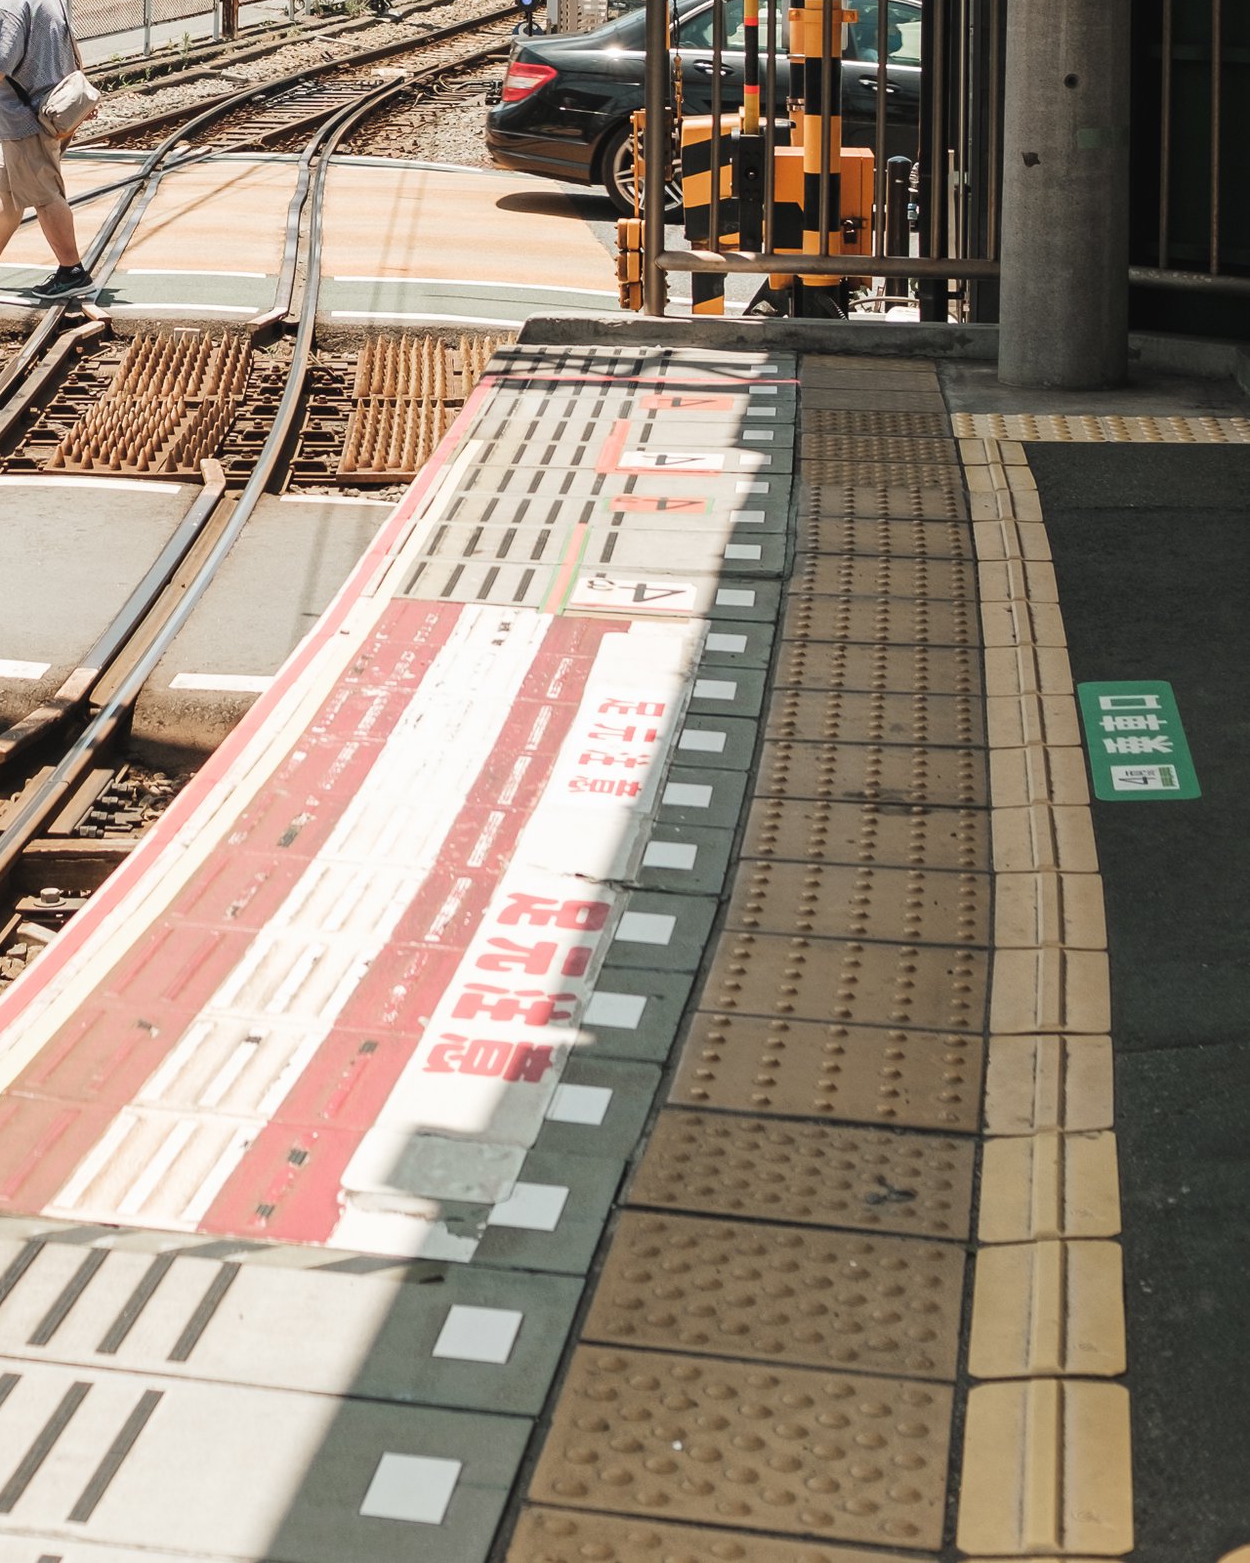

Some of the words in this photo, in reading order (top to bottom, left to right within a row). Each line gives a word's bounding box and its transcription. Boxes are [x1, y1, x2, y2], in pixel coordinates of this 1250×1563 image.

[564, 697, 665, 797] 足元注意
[1098, 695, 1174, 754] 乗車口
[422, 892, 612, 1084] 足元注意
